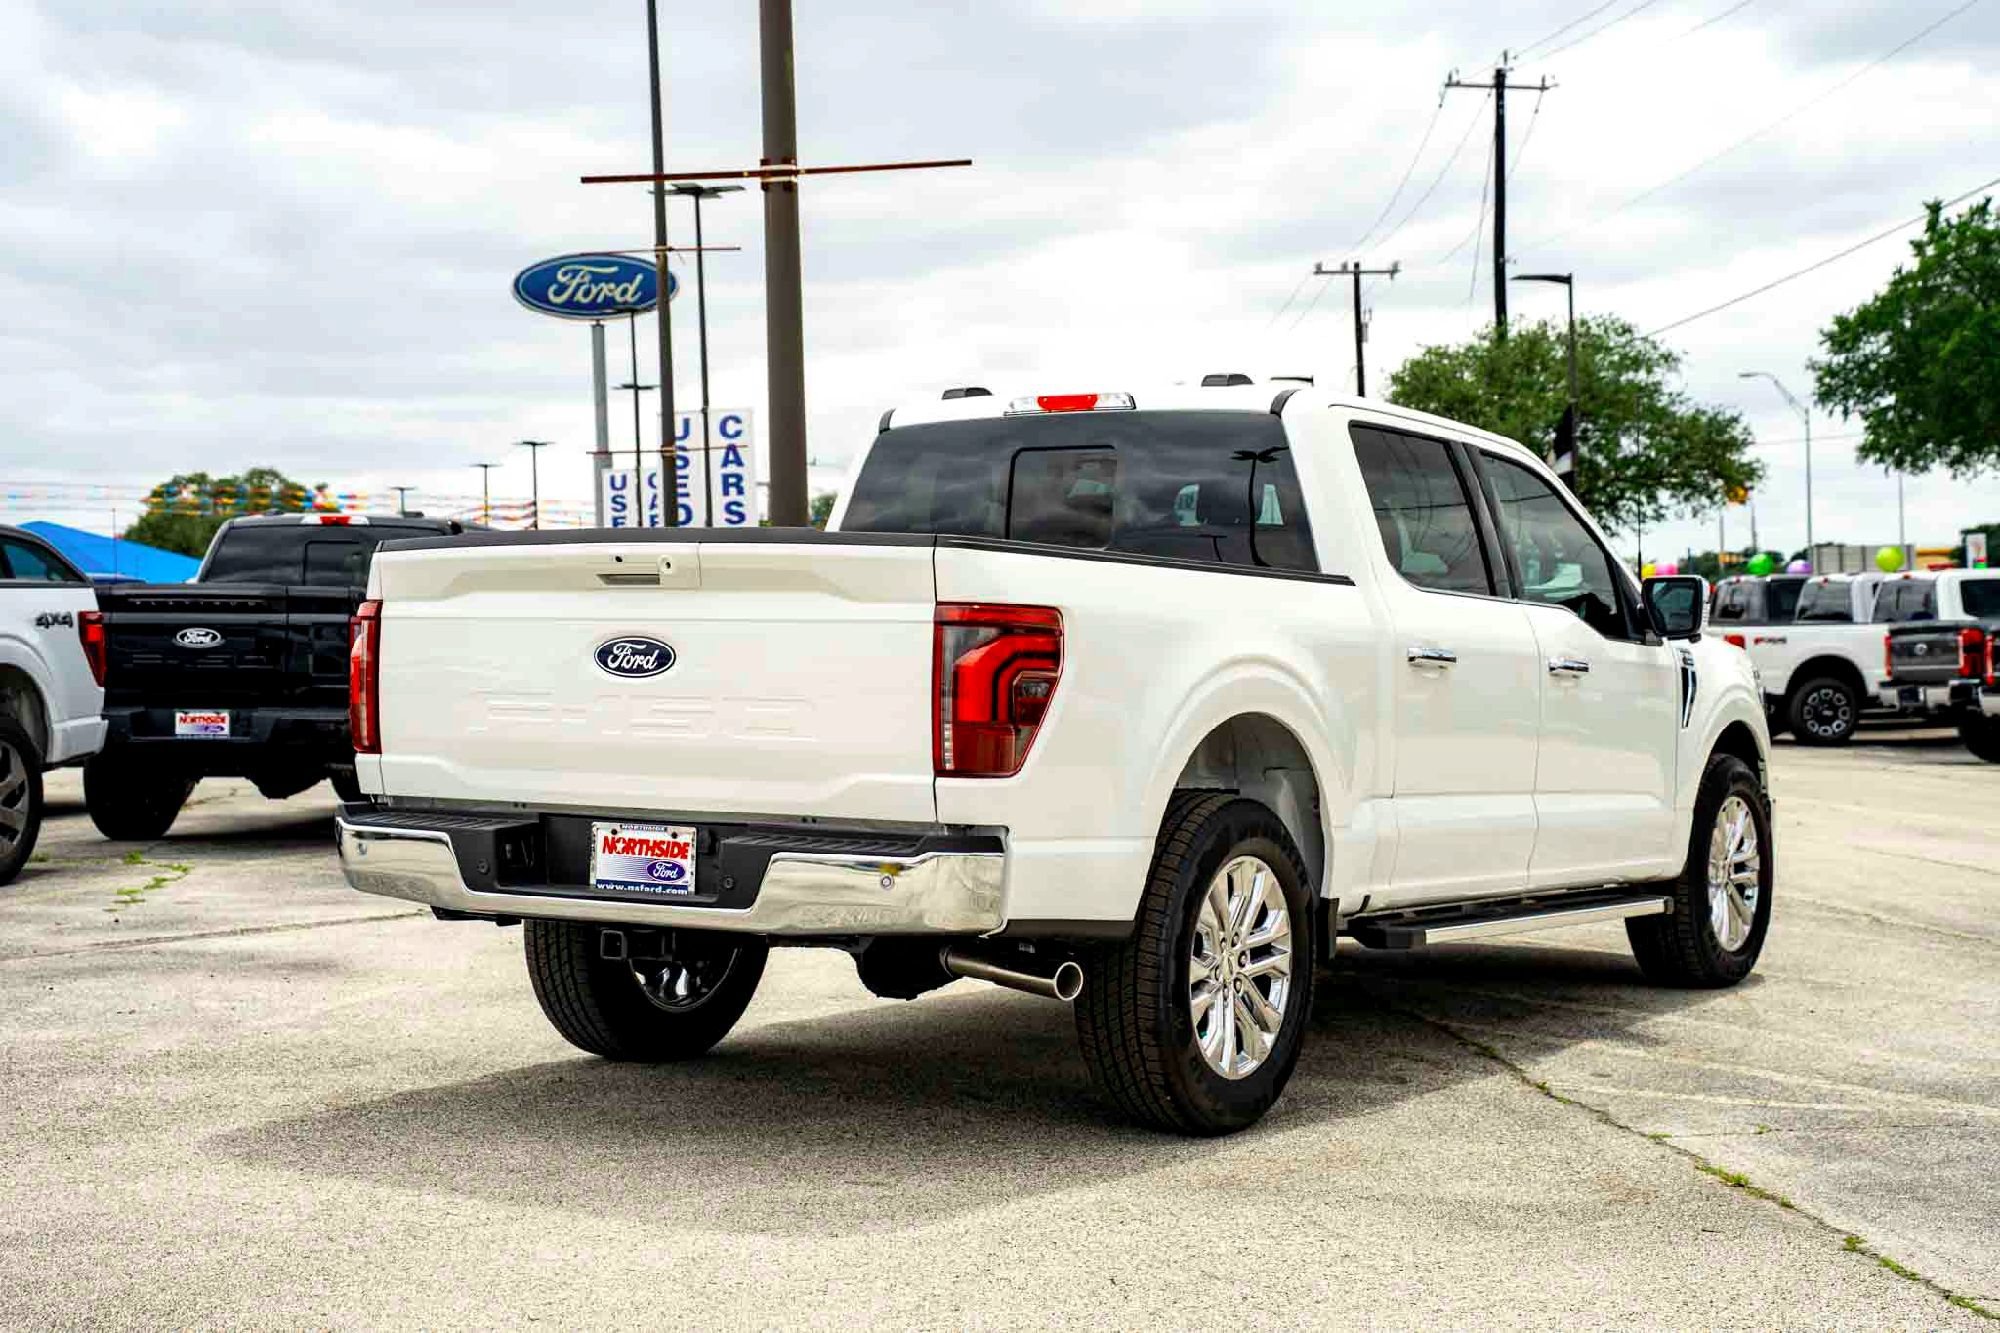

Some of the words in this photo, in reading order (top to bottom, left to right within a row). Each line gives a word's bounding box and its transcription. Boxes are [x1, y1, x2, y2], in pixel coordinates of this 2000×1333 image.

[547, 264, 644, 304] Ford
[718, 415, 746, 525] CARS
[609, 474, 627, 527] USE
[607, 642, 660, 670] Ford
[602, 835, 691, 860] NORTHSIDE
[652, 861, 679, 879] Ford
[596, 882, 688, 896] www.nsford.com
